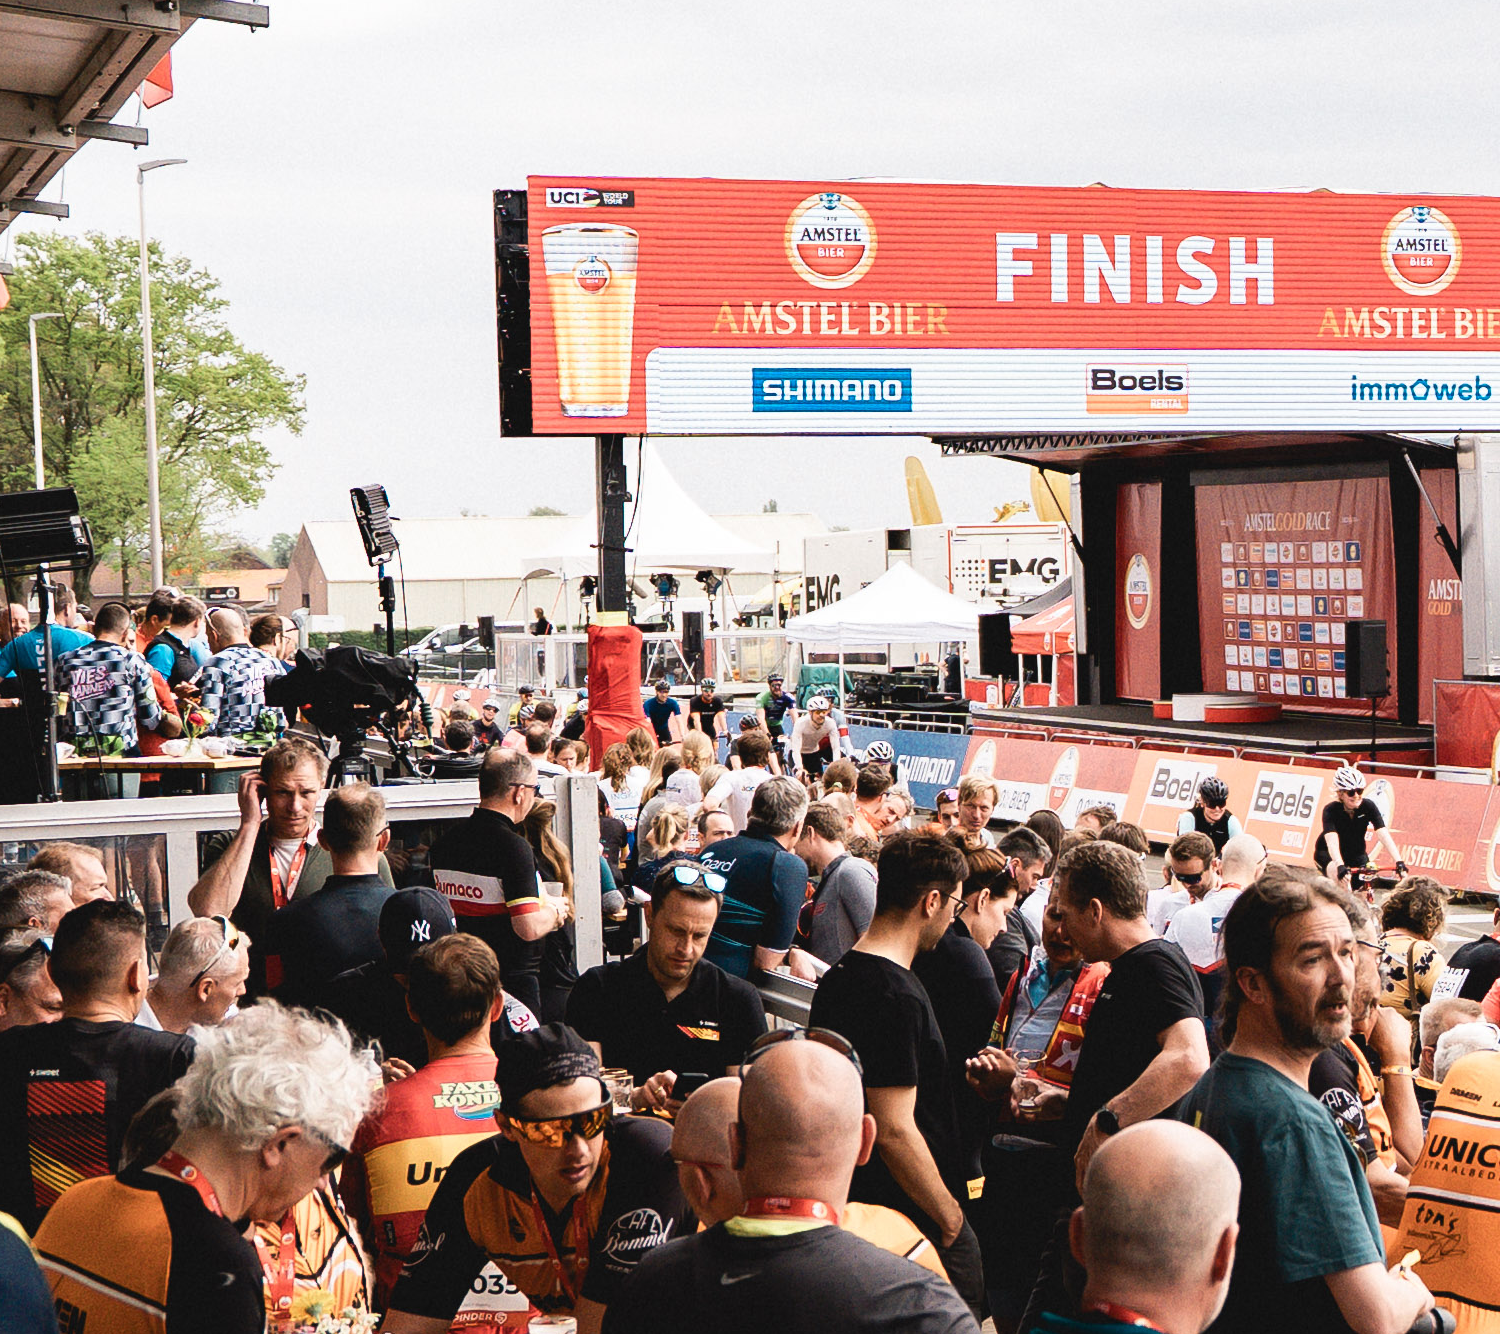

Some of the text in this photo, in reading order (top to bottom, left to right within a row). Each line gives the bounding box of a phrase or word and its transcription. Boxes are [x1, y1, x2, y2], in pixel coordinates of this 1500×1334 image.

[550, 191, 580, 205] UCI
[800, 227, 861, 242] AMSTEL
[1394, 238, 1448, 253] AMSTEL
[817, 247, 845, 258] BIER
[1409, 256, 1434, 267] BIER
[996, 232, 1274, 305] FINISH
[711, 300, 951, 335] AMSTEL BIER
[1316, 305, 1447, 339] AMSTEL
[762, 379, 902, 402] SHIMANO
[1091, 368, 1184, 392] Boels
[1351, 374, 1492, 402] immoweb
[988, 556, 1061, 584] EMG
[805, 573, 842, 615] EMG
[1428, 578, 1463, 601] AMST
[1428, 600, 1451, 616] GOLD
[896, 754, 957, 786] SHIMANO
[1253, 779, 1315, 819] Boels
[1436, 847, 1465, 872] BIER
[440, 1080, 499, 1097] FAXE
[1449, 1086, 1483, 1102] DAMEN
[453, 1310, 495, 1325] PINDER
